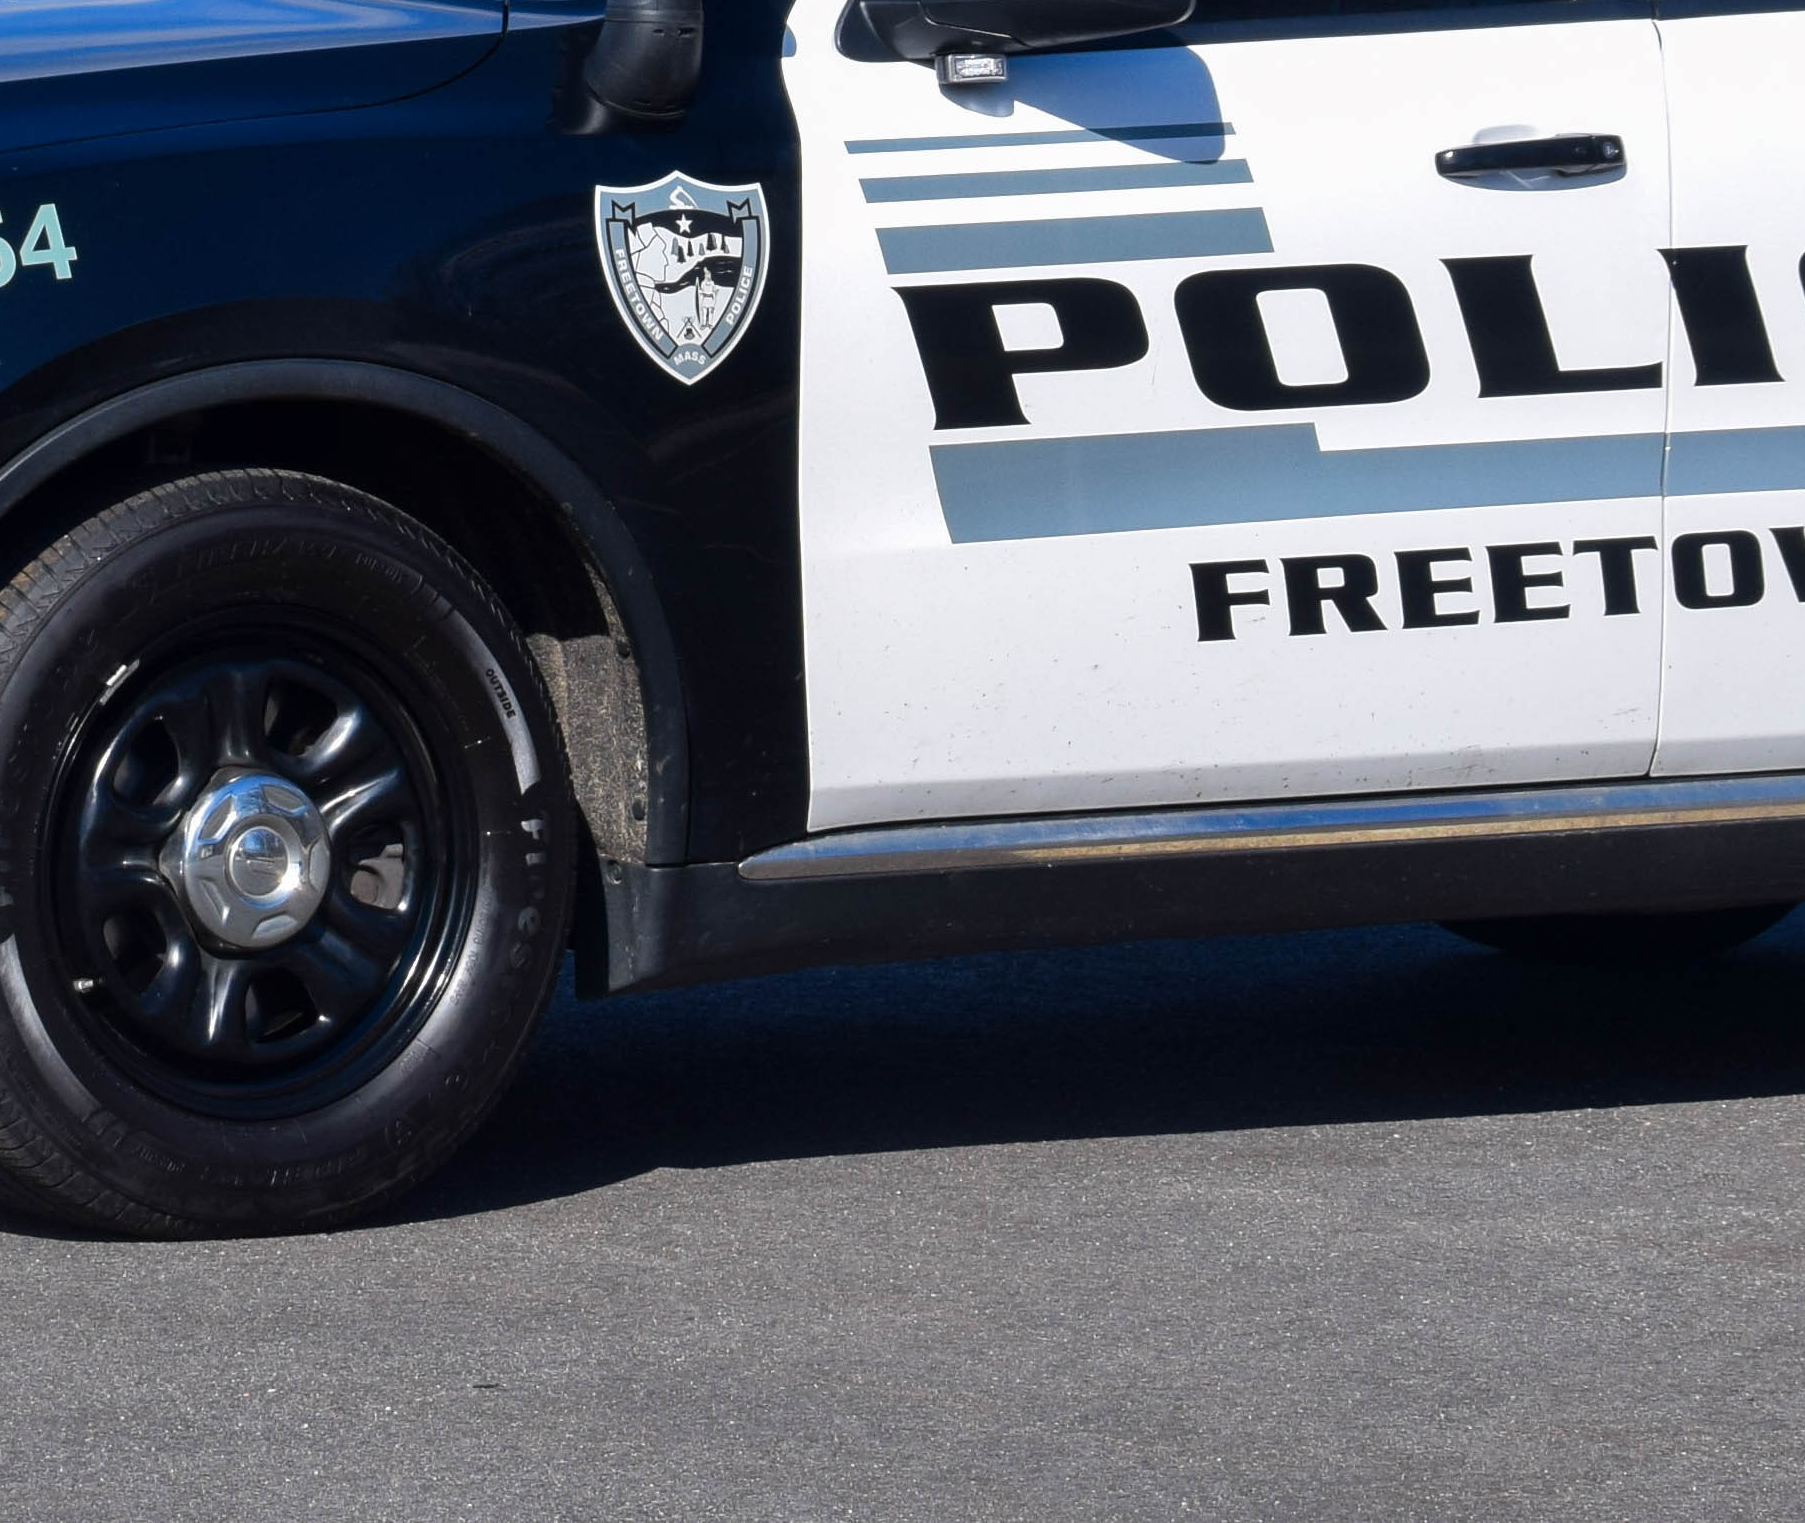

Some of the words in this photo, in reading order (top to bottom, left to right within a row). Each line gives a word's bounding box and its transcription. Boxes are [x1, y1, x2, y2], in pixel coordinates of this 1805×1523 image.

[615, 248, 664, 342] FREETOWN
[726, 266, 754, 326] POLICE
[673, 350, 707, 366] MASS
[485, 668, 517, 719] OUTSIDE
